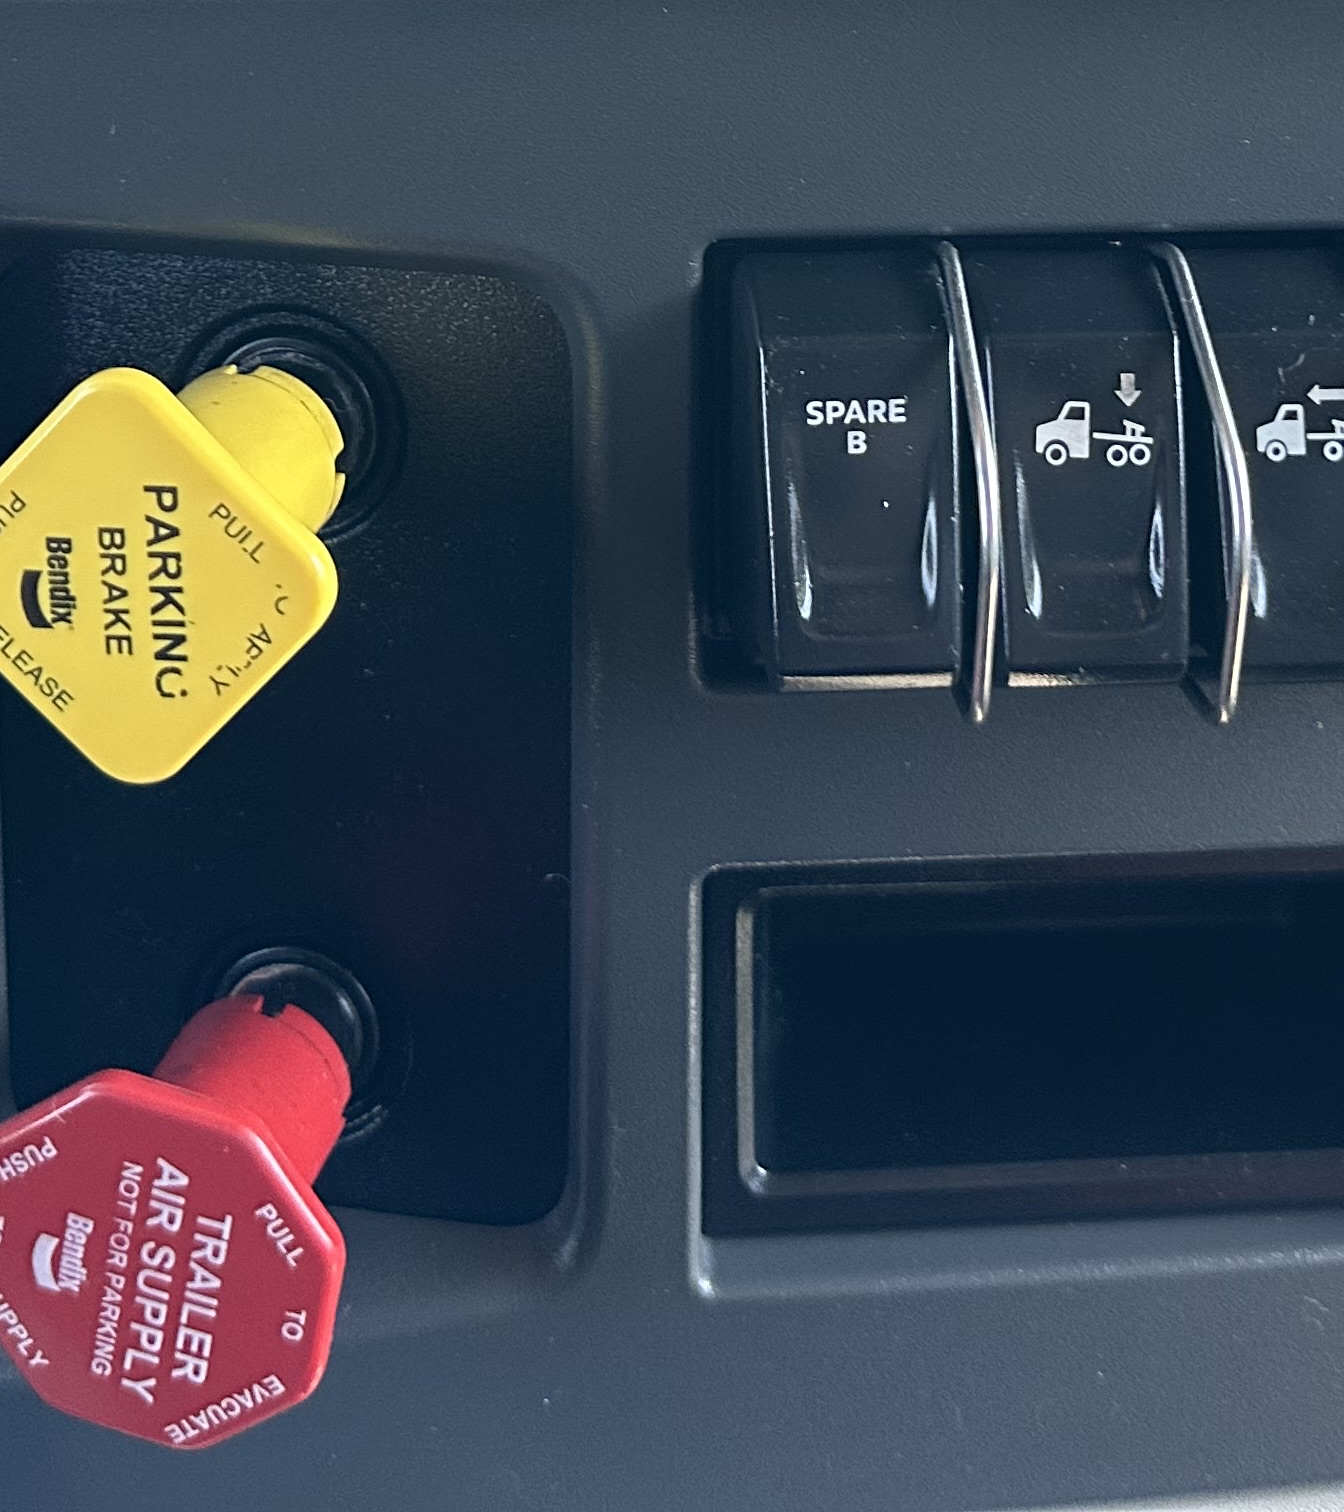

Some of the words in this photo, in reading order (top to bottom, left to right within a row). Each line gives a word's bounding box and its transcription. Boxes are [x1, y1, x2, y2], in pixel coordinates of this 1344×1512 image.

[806, 399, 907, 426] SPARE
[847, 430, 868, 455] B
[208, 502, 265, 565] PULL
[45, 536, 78, 629] Bendix
[98, 526, 134, 656] BRAKE
[116, 1161, 144, 1215] NOT
[145, 1157, 190, 1234] AIR
[56, 1212, 95, 1296] Bendix
[105, 1215, 133, 1277] FOR
[255, 1202, 307, 1268] PULL
[90, 1272, 127, 1377] PARKING
[120, 1240, 177, 1405] SUPPLY
[170, 1214, 233, 1385] TRAILER
[280, 1309, 307, 1342] TO
[164, 1374, 286, 1444] EVACUATE
